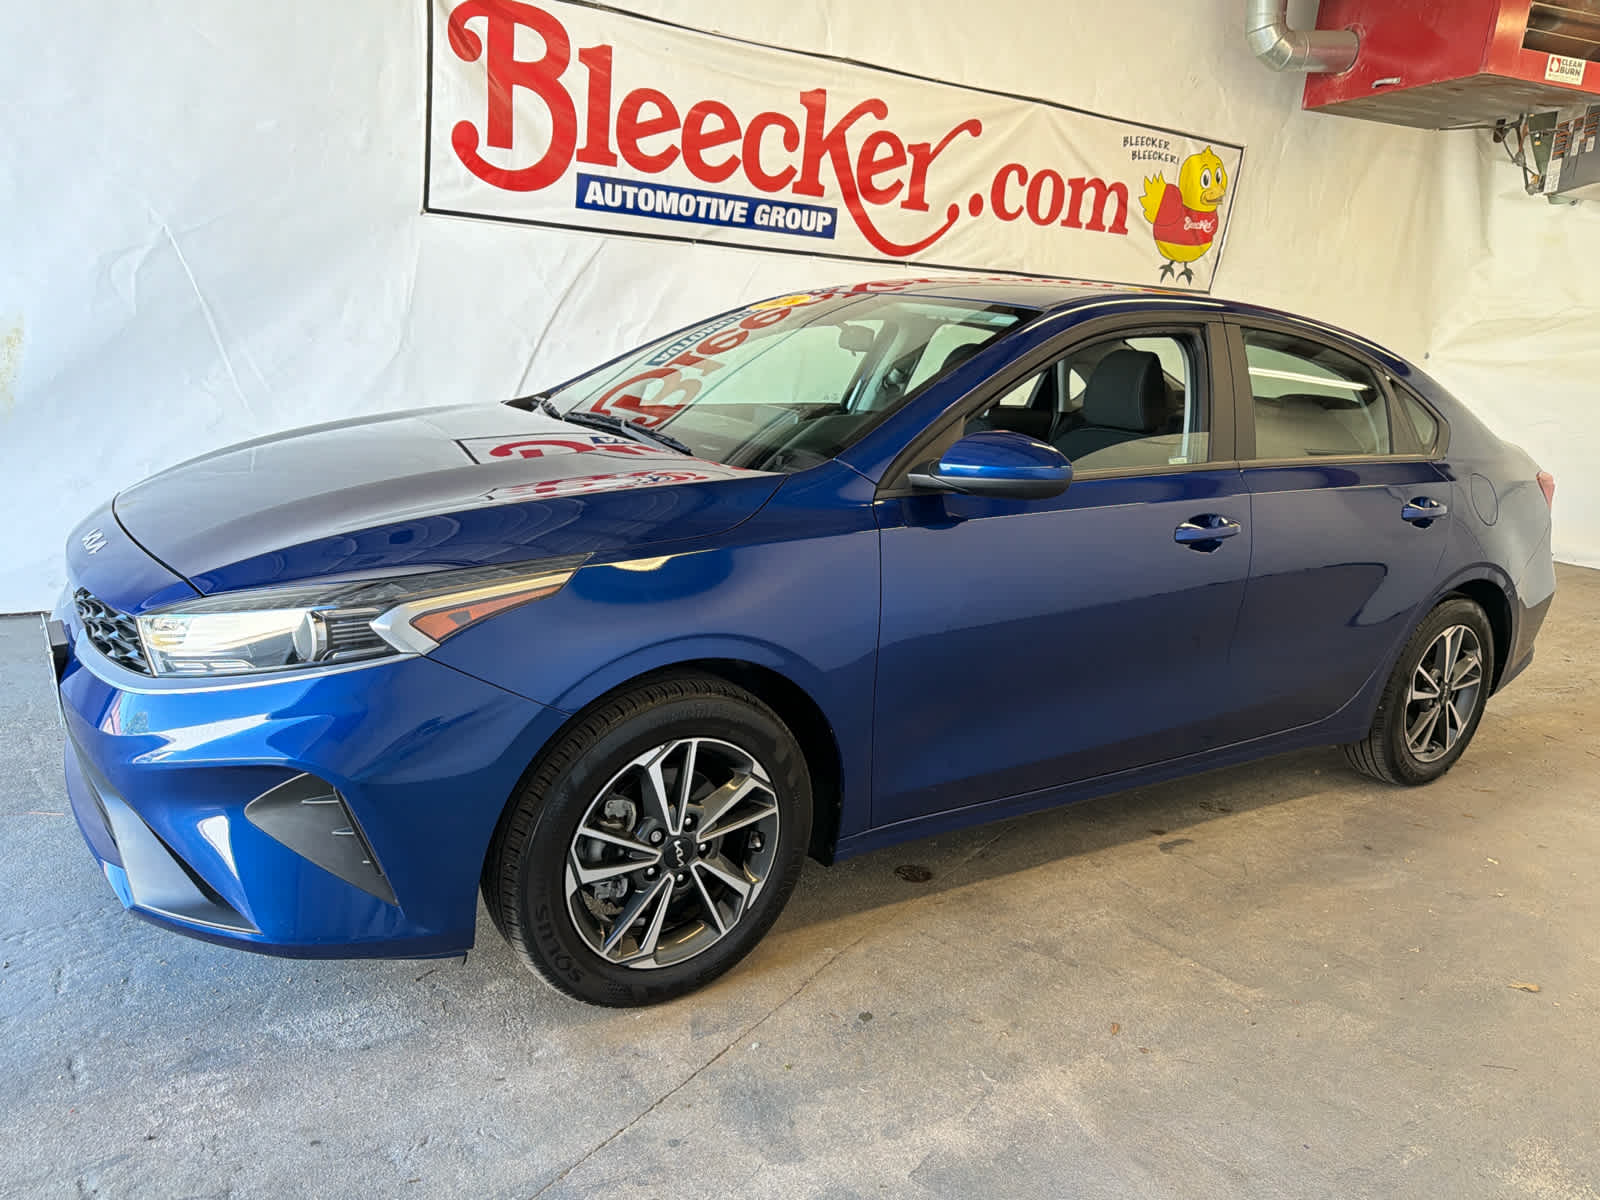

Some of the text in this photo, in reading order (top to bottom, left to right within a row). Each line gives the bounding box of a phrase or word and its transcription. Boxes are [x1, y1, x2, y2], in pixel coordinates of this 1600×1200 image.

[1561, 58, 1583, 69] CLEAN
[1559, 66, 1581, 77] BURN
[1122, 135, 1171, 150] BLEECKER
[584, 180, 832, 233] AUTOMOTIVE GROUP
